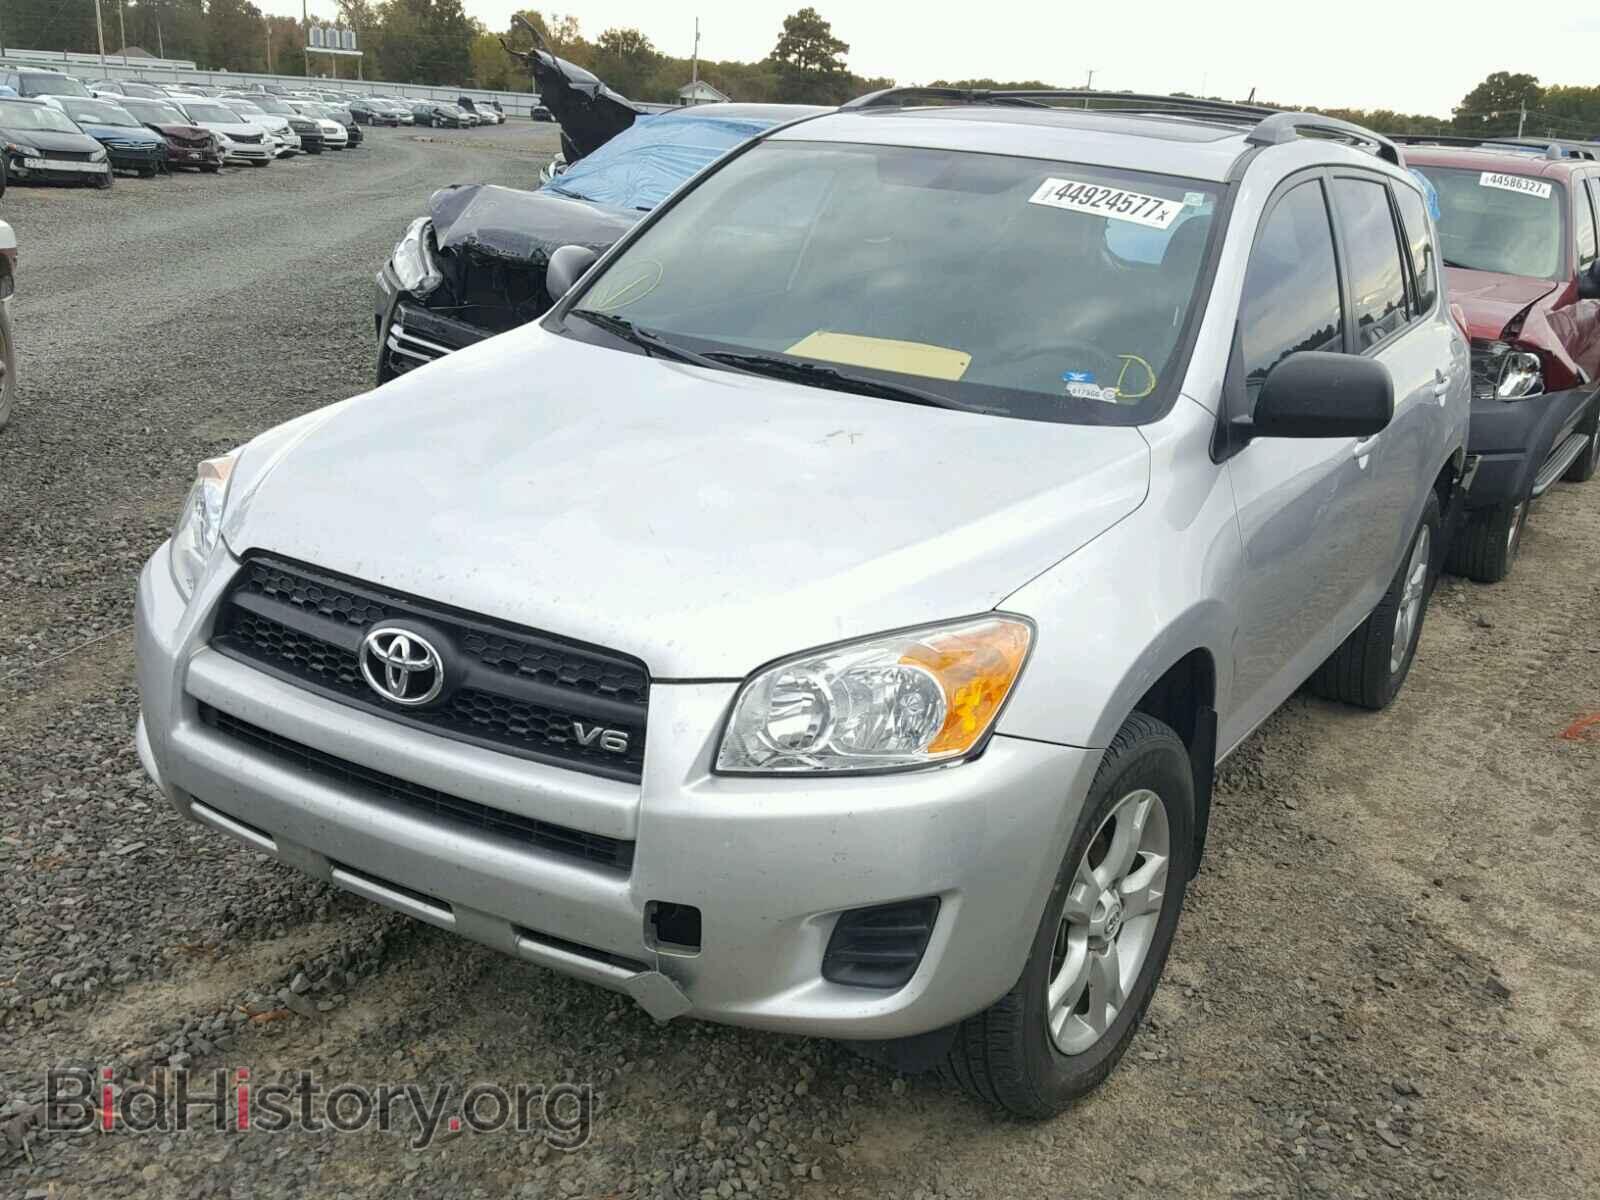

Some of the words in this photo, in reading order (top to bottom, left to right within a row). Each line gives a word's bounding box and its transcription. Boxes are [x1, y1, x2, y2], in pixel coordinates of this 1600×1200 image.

[1490, 175, 1542, 192] 44586327
[1055, 182, 1164, 218] 44924577
[573, 722, 629, 752] V6
